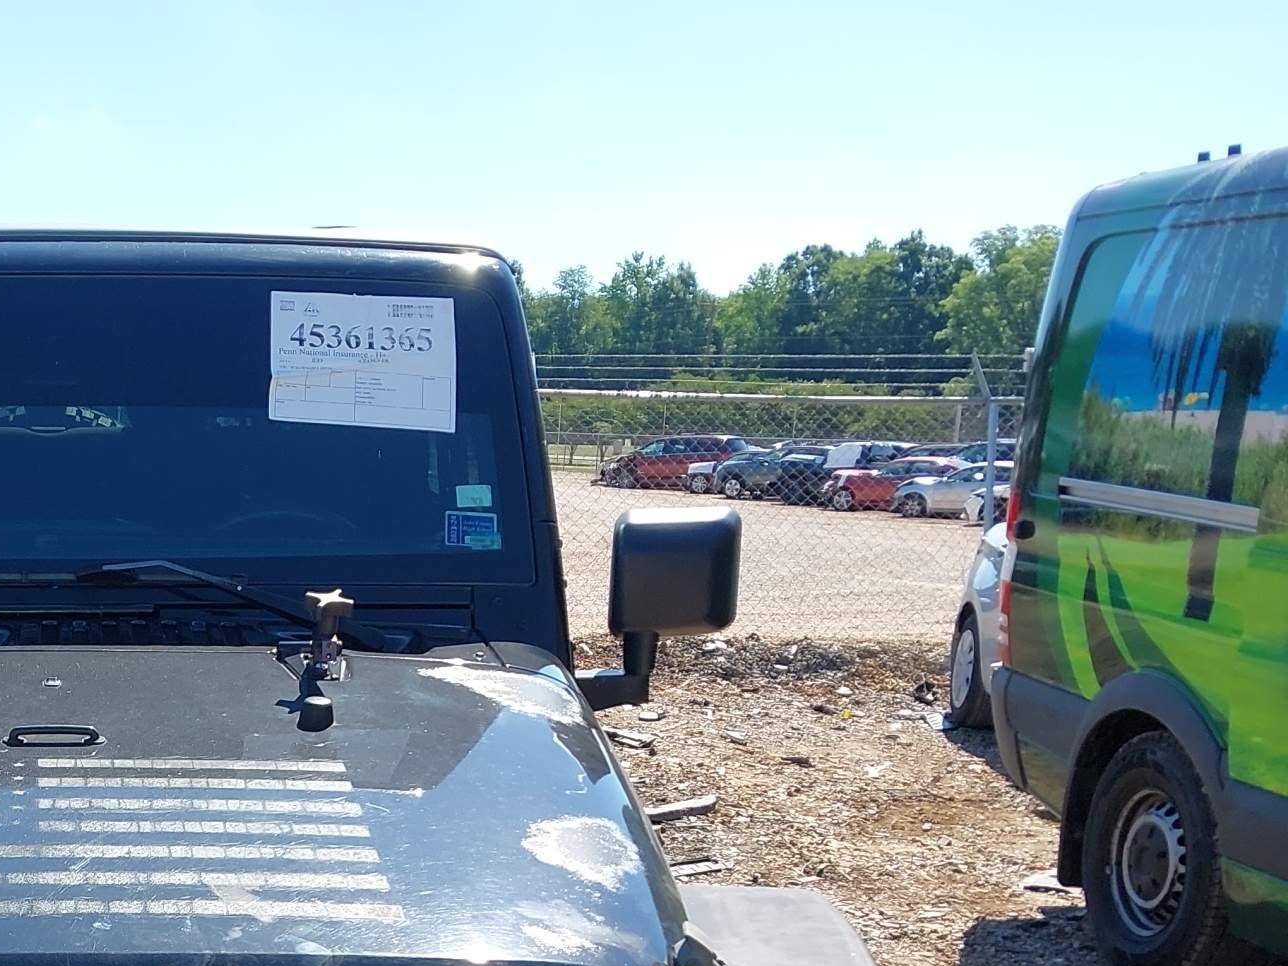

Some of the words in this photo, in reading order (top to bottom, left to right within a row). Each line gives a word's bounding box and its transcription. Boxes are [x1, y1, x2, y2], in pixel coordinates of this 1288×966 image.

[289, 323, 433, 351] 45361365
[279, 347, 297, 355] Penn
[299, 348, 331, 357] National
[333, 350, 369, 358] Insurance
